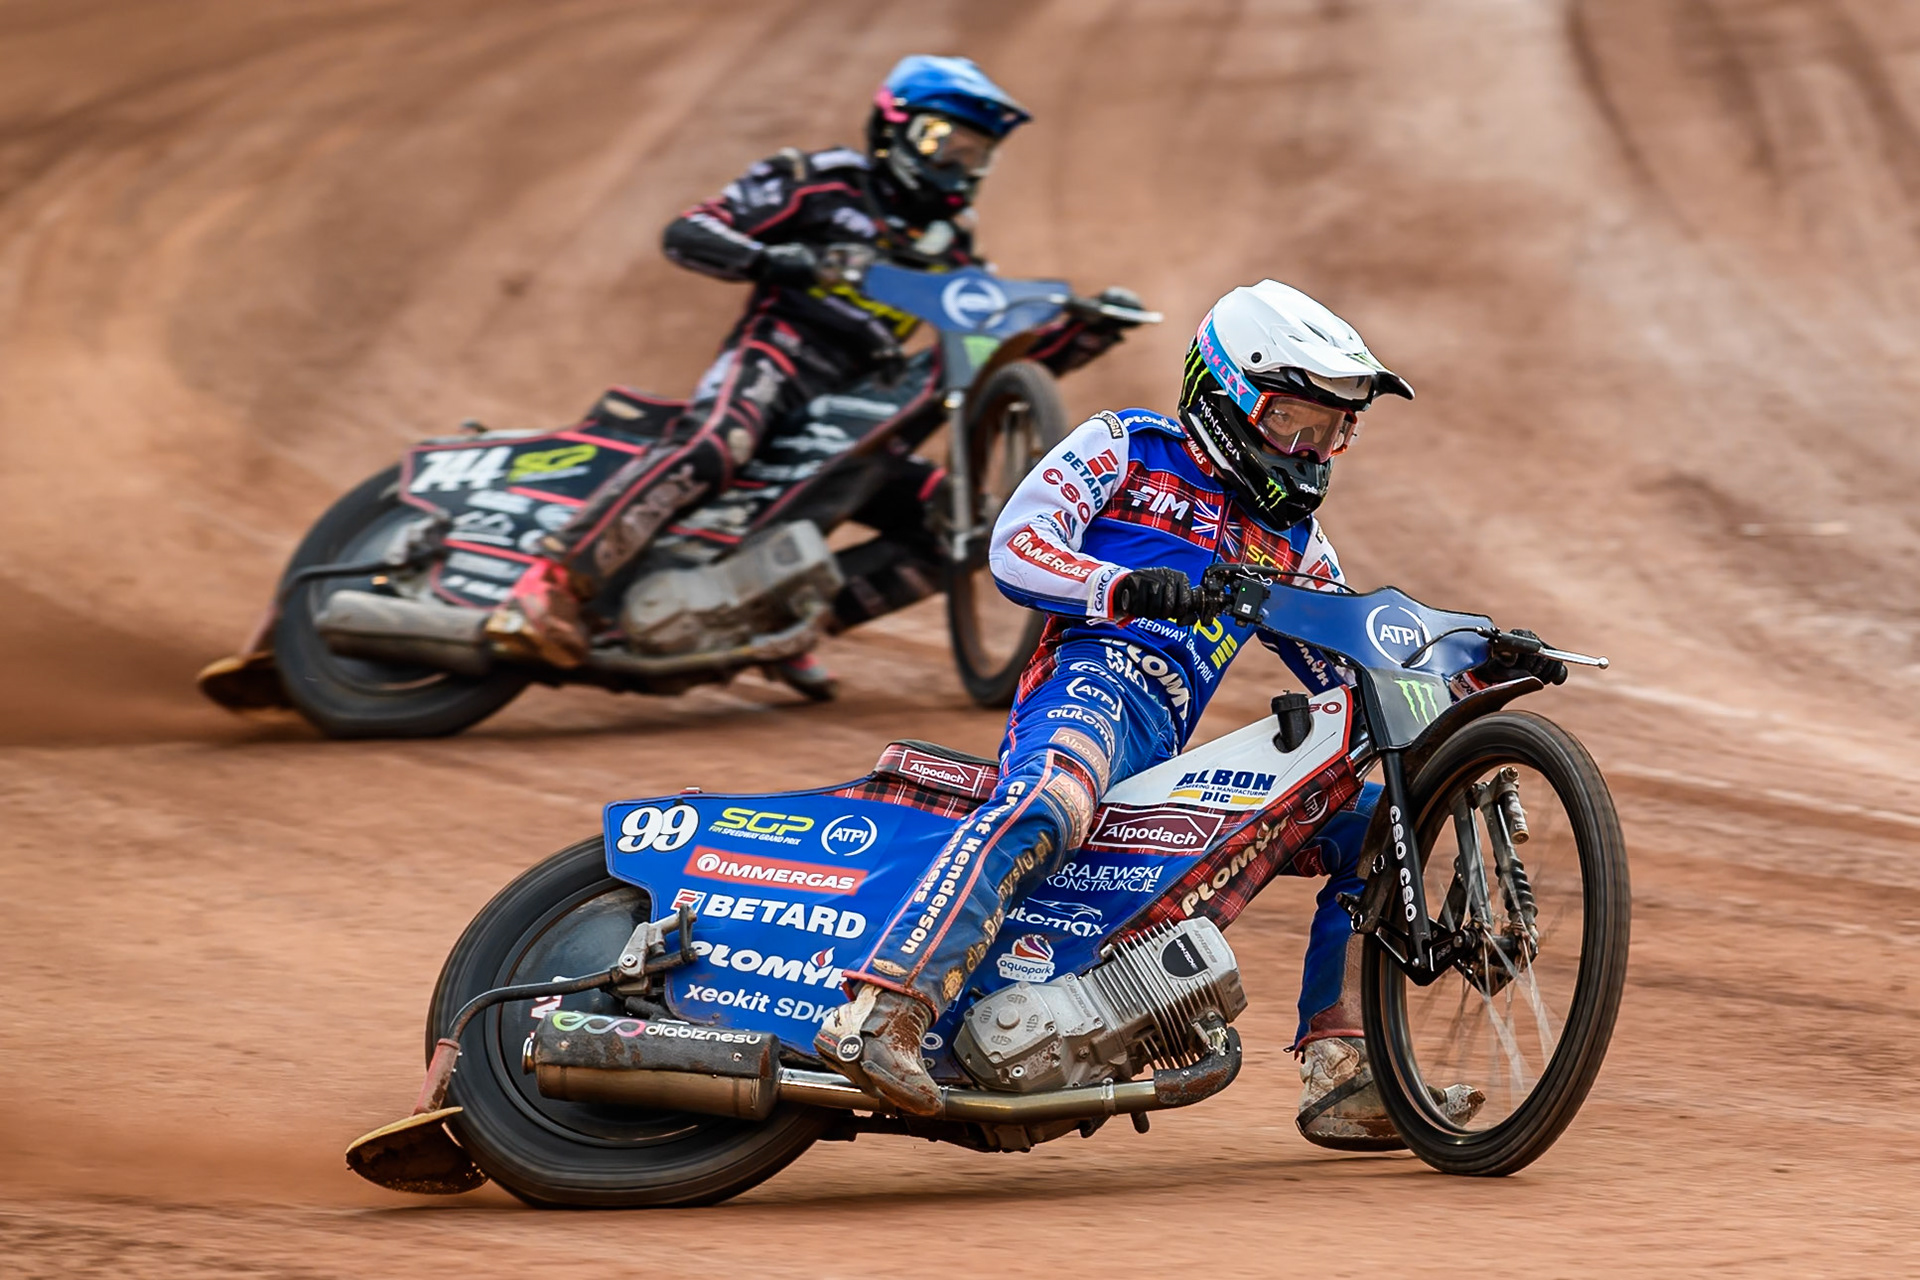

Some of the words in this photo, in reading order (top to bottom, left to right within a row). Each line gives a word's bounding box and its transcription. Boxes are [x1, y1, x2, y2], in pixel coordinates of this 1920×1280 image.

[1062, 451, 1103, 510] BETARD
[1043, 468, 1090, 524] CSO
[1131, 486, 1190, 521] FIM
[1380, 624, 1421, 648] ATPI
[1131, 617, 1187, 642] PEEDWAY
[1198, 661, 1215, 684] PRIX
[911, 763, 965, 784] Alpodach
[1175, 769, 1277, 791] ALBON
[975, 781, 1027, 836] Grant
[1200, 791, 1231, 804] plc
[616, 804, 700, 854] 99
[713, 807, 815, 835] SGP
[1103, 823, 1199, 847] Alpodach
[1390, 805, 1407, 860] CSO
[721, 827, 759, 841] SPEEDWAY
[758, 833, 784, 844] GRAND
[782, 836, 802, 846] PRIX
[829, 827, 869, 844] ATPI
[717, 864, 855, 890] IMMERGAS
[1057, 862, 1164, 880] RAJEWSKI
[900, 837, 983, 954] Henderson
[1400, 867, 1417, 923] CSO
[703, 894, 867, 939] BETARD
[1000, 960, 1052, 975] aquapark
[684, 984, 770, 1013] xeokit
[774, 997, 835, 1024] SDK
[841, 1043, 860, 1054] 99
